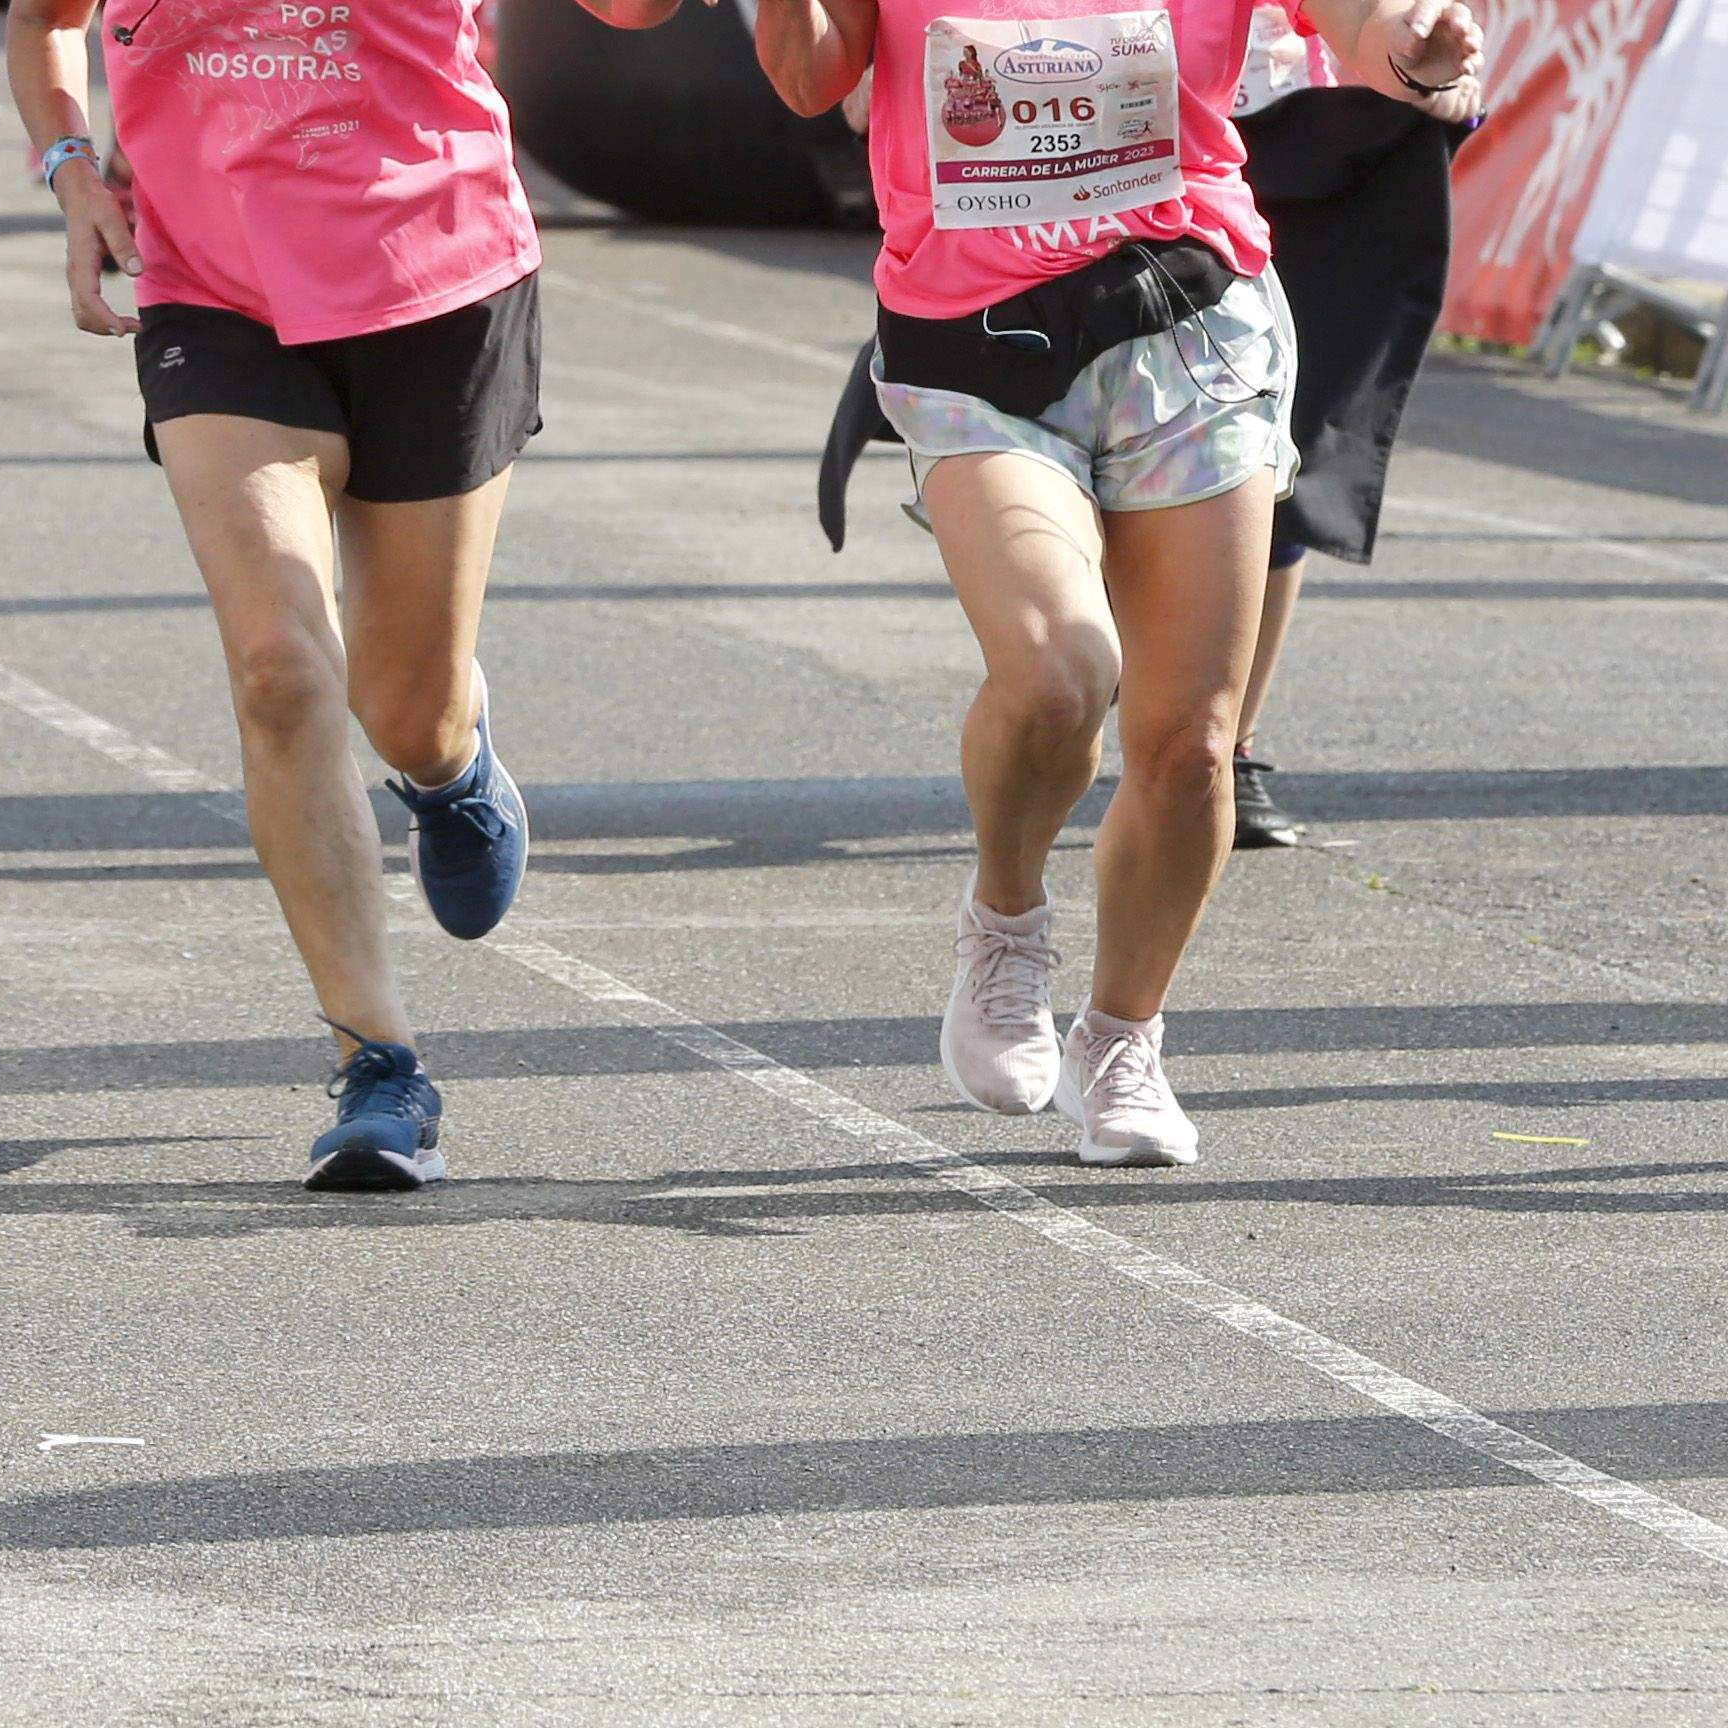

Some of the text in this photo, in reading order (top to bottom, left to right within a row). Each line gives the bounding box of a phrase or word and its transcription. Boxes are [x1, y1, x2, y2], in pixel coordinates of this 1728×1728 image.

[280, 3, 351, 28] POR
[1111, 43, 1158, 58] SUMA
[186, 51, 363, 83] NOSOTRAS
[1003, 57, 1095, 74] ASTURIANA
[1012, 96, 1096, 124] 016
[332, 120, 360, 135] 2021
[1030, 133, 1082, 153] 2353
[962, 146, 1155, 178] CARRERA DE LA MUJER 2023
[957, 172, 1163, 212] OYSHO Santander
